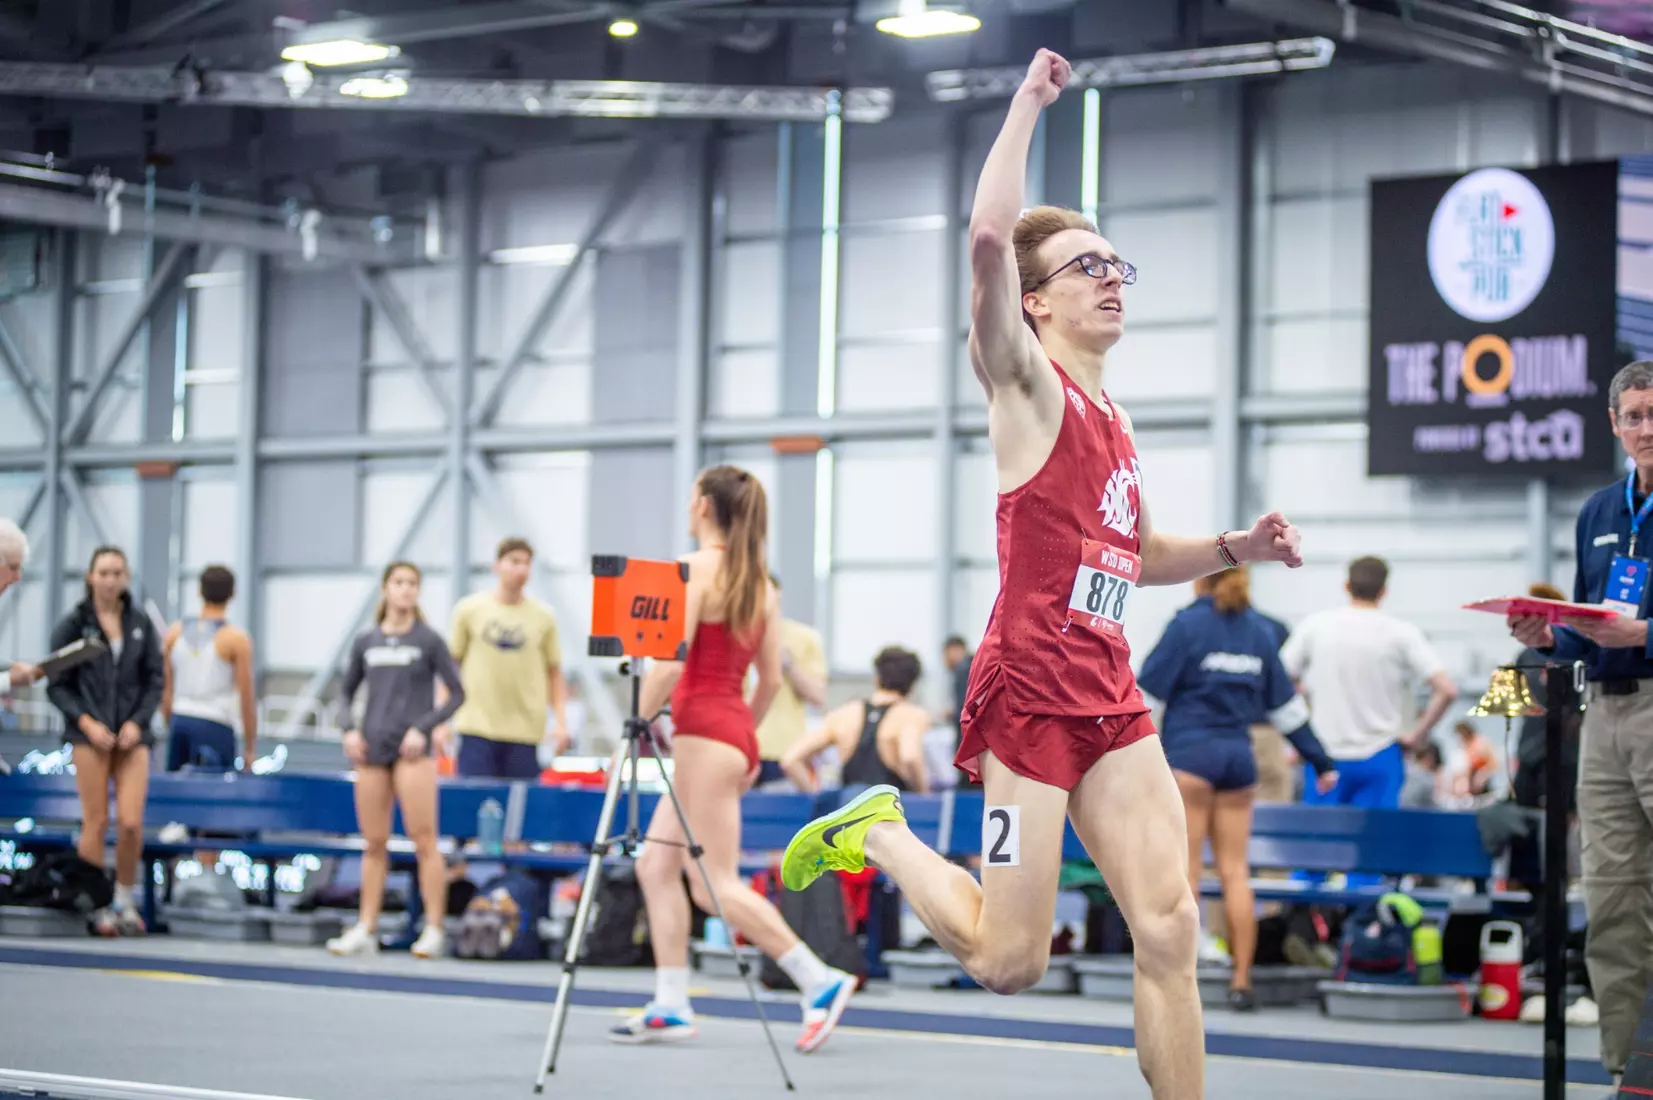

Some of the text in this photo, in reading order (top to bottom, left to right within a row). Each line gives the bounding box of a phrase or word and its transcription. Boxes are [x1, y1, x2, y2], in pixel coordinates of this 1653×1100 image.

[1384, 342, 1439, 405] THE
[1117, 556, 1134, 574] OPEN
[631, 595, 670, 621] GILL
[1086, 572, 1129, 620] 878
[989, 809, 1011, 863] 2
